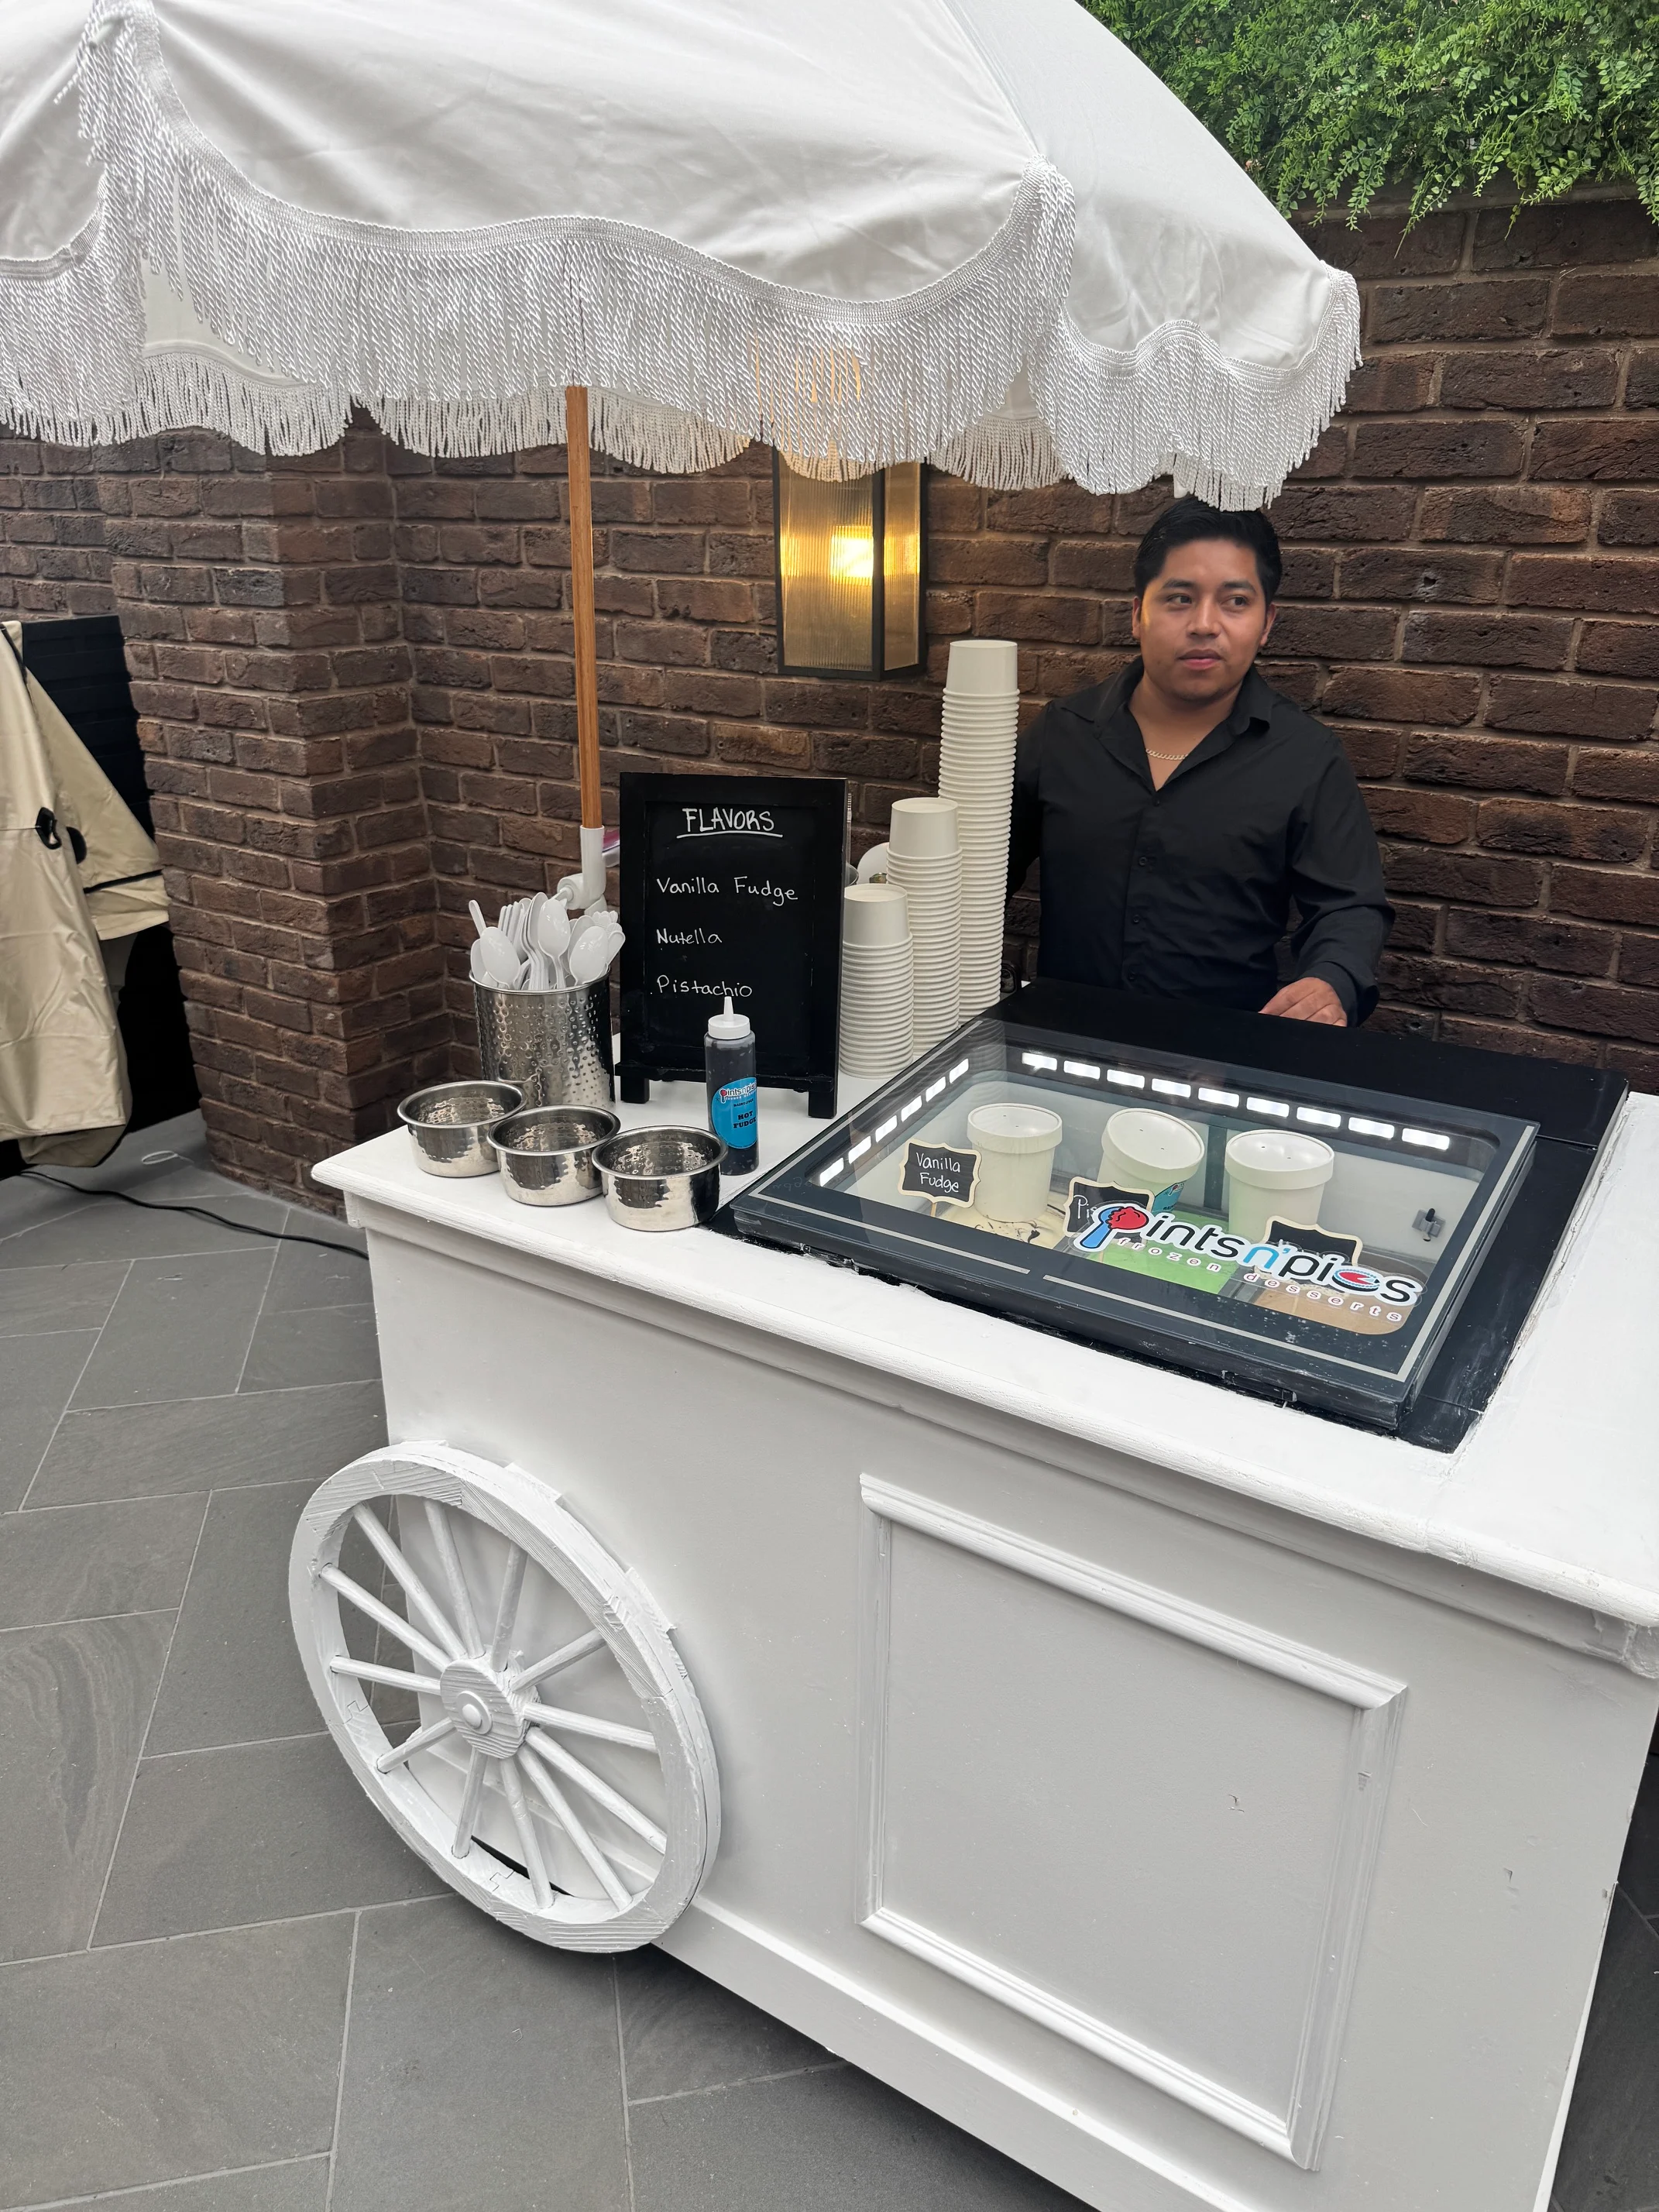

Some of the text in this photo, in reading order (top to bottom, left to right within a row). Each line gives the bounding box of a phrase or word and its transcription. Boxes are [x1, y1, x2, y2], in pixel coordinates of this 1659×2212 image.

[682, 807, 775, 832] FLAVORS
[656, 876, 799, 906] Vanilla Fudge
[656, 928, 723, 944] Nutella
[656, 974, 753, 997] Pistachio
[733, 1117, 757, 1128] FUDGE
[737, 1111, 754, 1121] HOT
[915, 1152, 960, 1173] Vanilla
[919, 1172, 959, 1194] Fudge
[1118, 1238, 1401, 1321] frozen desserts
